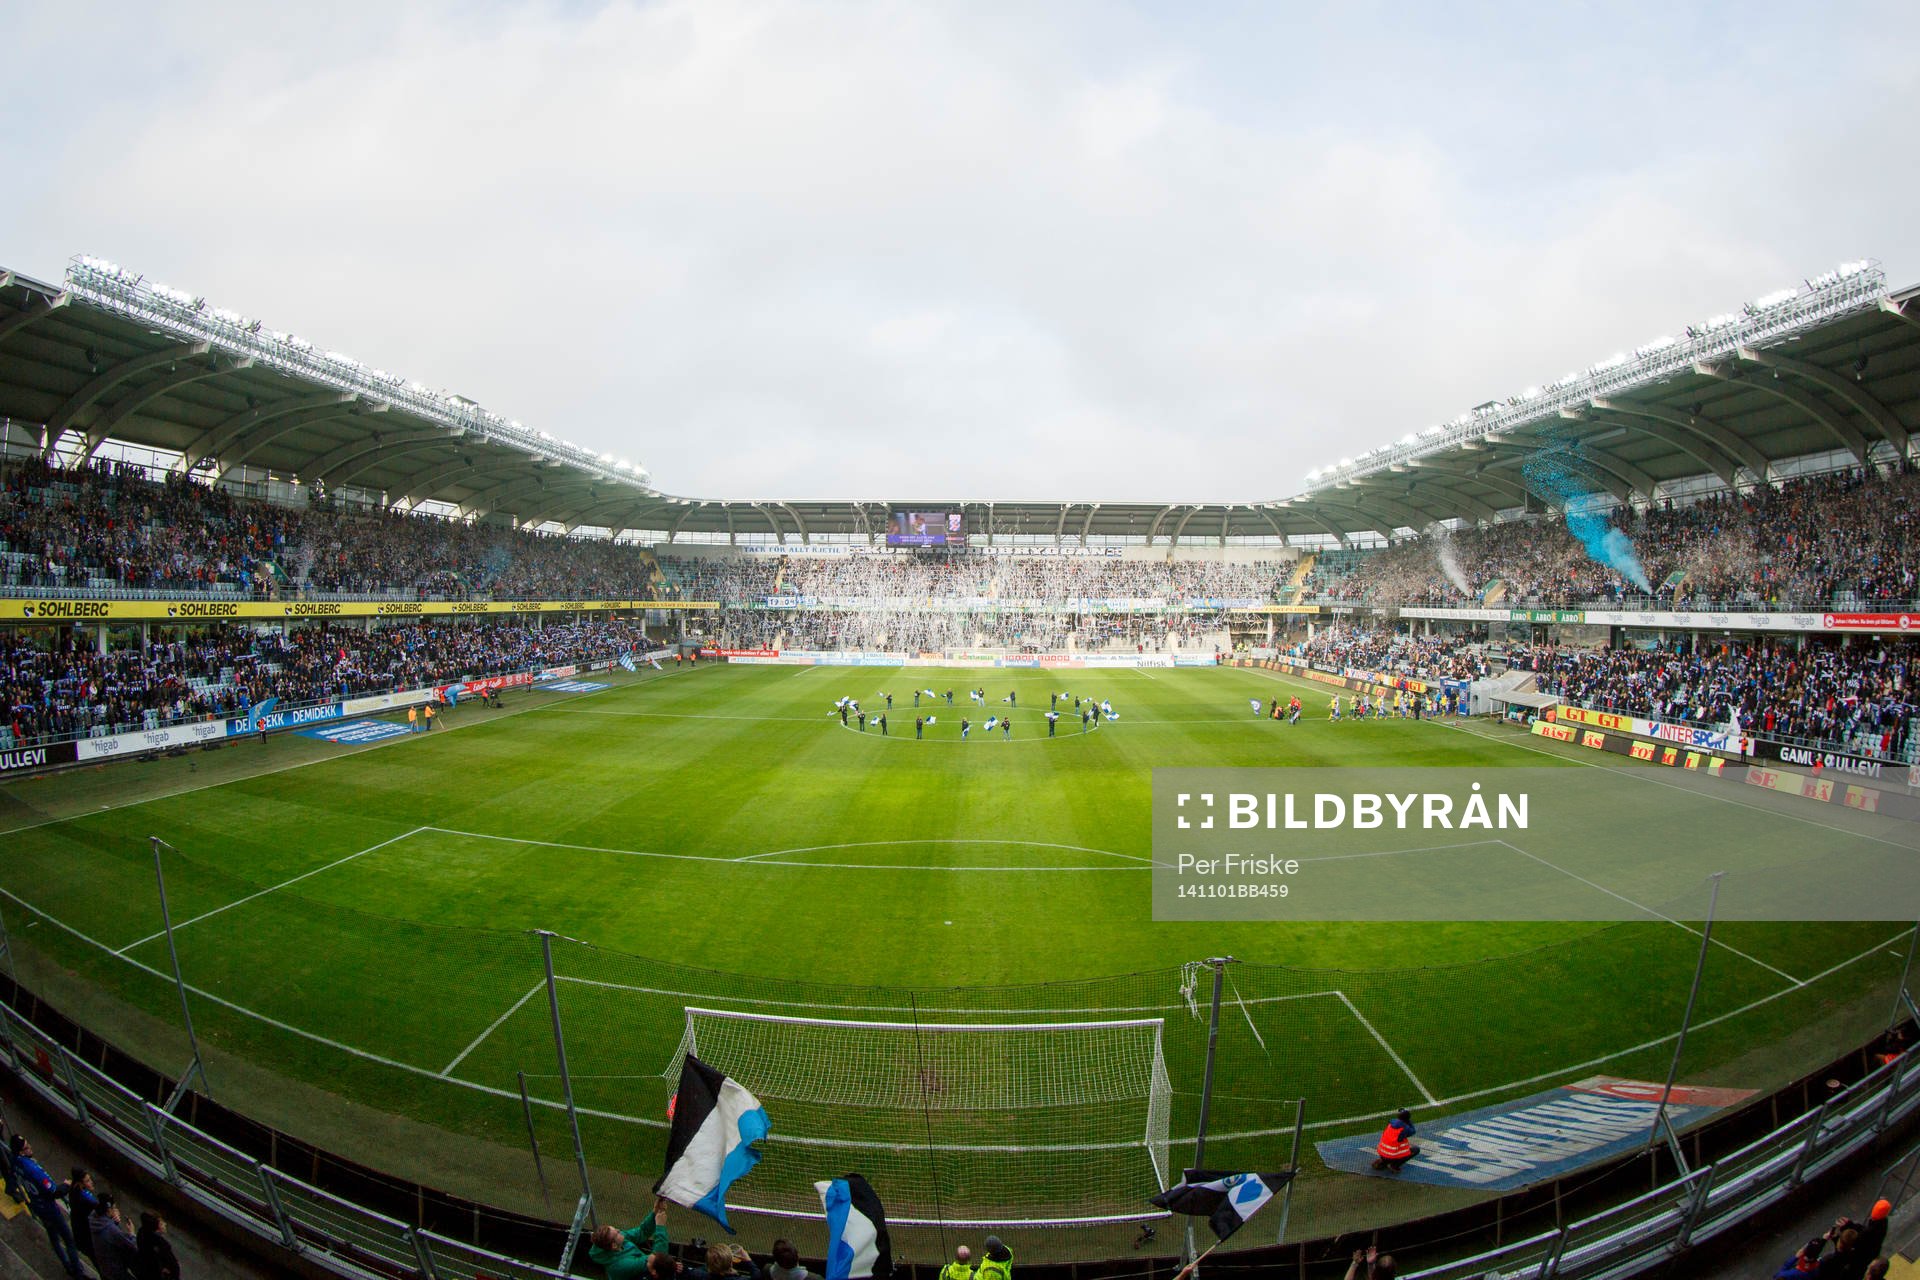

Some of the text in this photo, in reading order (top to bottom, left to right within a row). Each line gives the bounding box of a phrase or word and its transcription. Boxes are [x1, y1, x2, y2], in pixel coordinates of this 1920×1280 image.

[38, 601, 109, 617] SOHLBERG
[180, 603, 238, 616] SOHLBERG
[294, 603, 341, 615] SOHLBERG
[385, 603, 423, 613] SOHLBERG
[458, 603, 488, 612] SOHLBERG
[1512, 612, 1527, 621] ÅBRO
[1535, 613, 1552, 622] ÅBRO
[1561, 613, 1579, 623] ÅBRO
[1710, 614, 1728, 626] higab
[1750, 615, 1770, 627] higab
[1793, 615, 1815, 628] higab
[1137, 660, 1167, 668] Nilfisk
[1409, 680, 1421, 692] GT
[293, 704, 337, 723] DEMIDEKK
[1566, 707, 1624, 729] GT GT
[235, 712, 285, 733] DEEKK
[195, 724, 217, 738] higab
[1542, 726, 1573, 742] BÄST
[147, 731, 170, 746] higab
[94, 739, 119, 753] higab
[0, 748, 47, 770] ULLEVI
[1780, 746, 1882, 778] GAML ULLEVI
